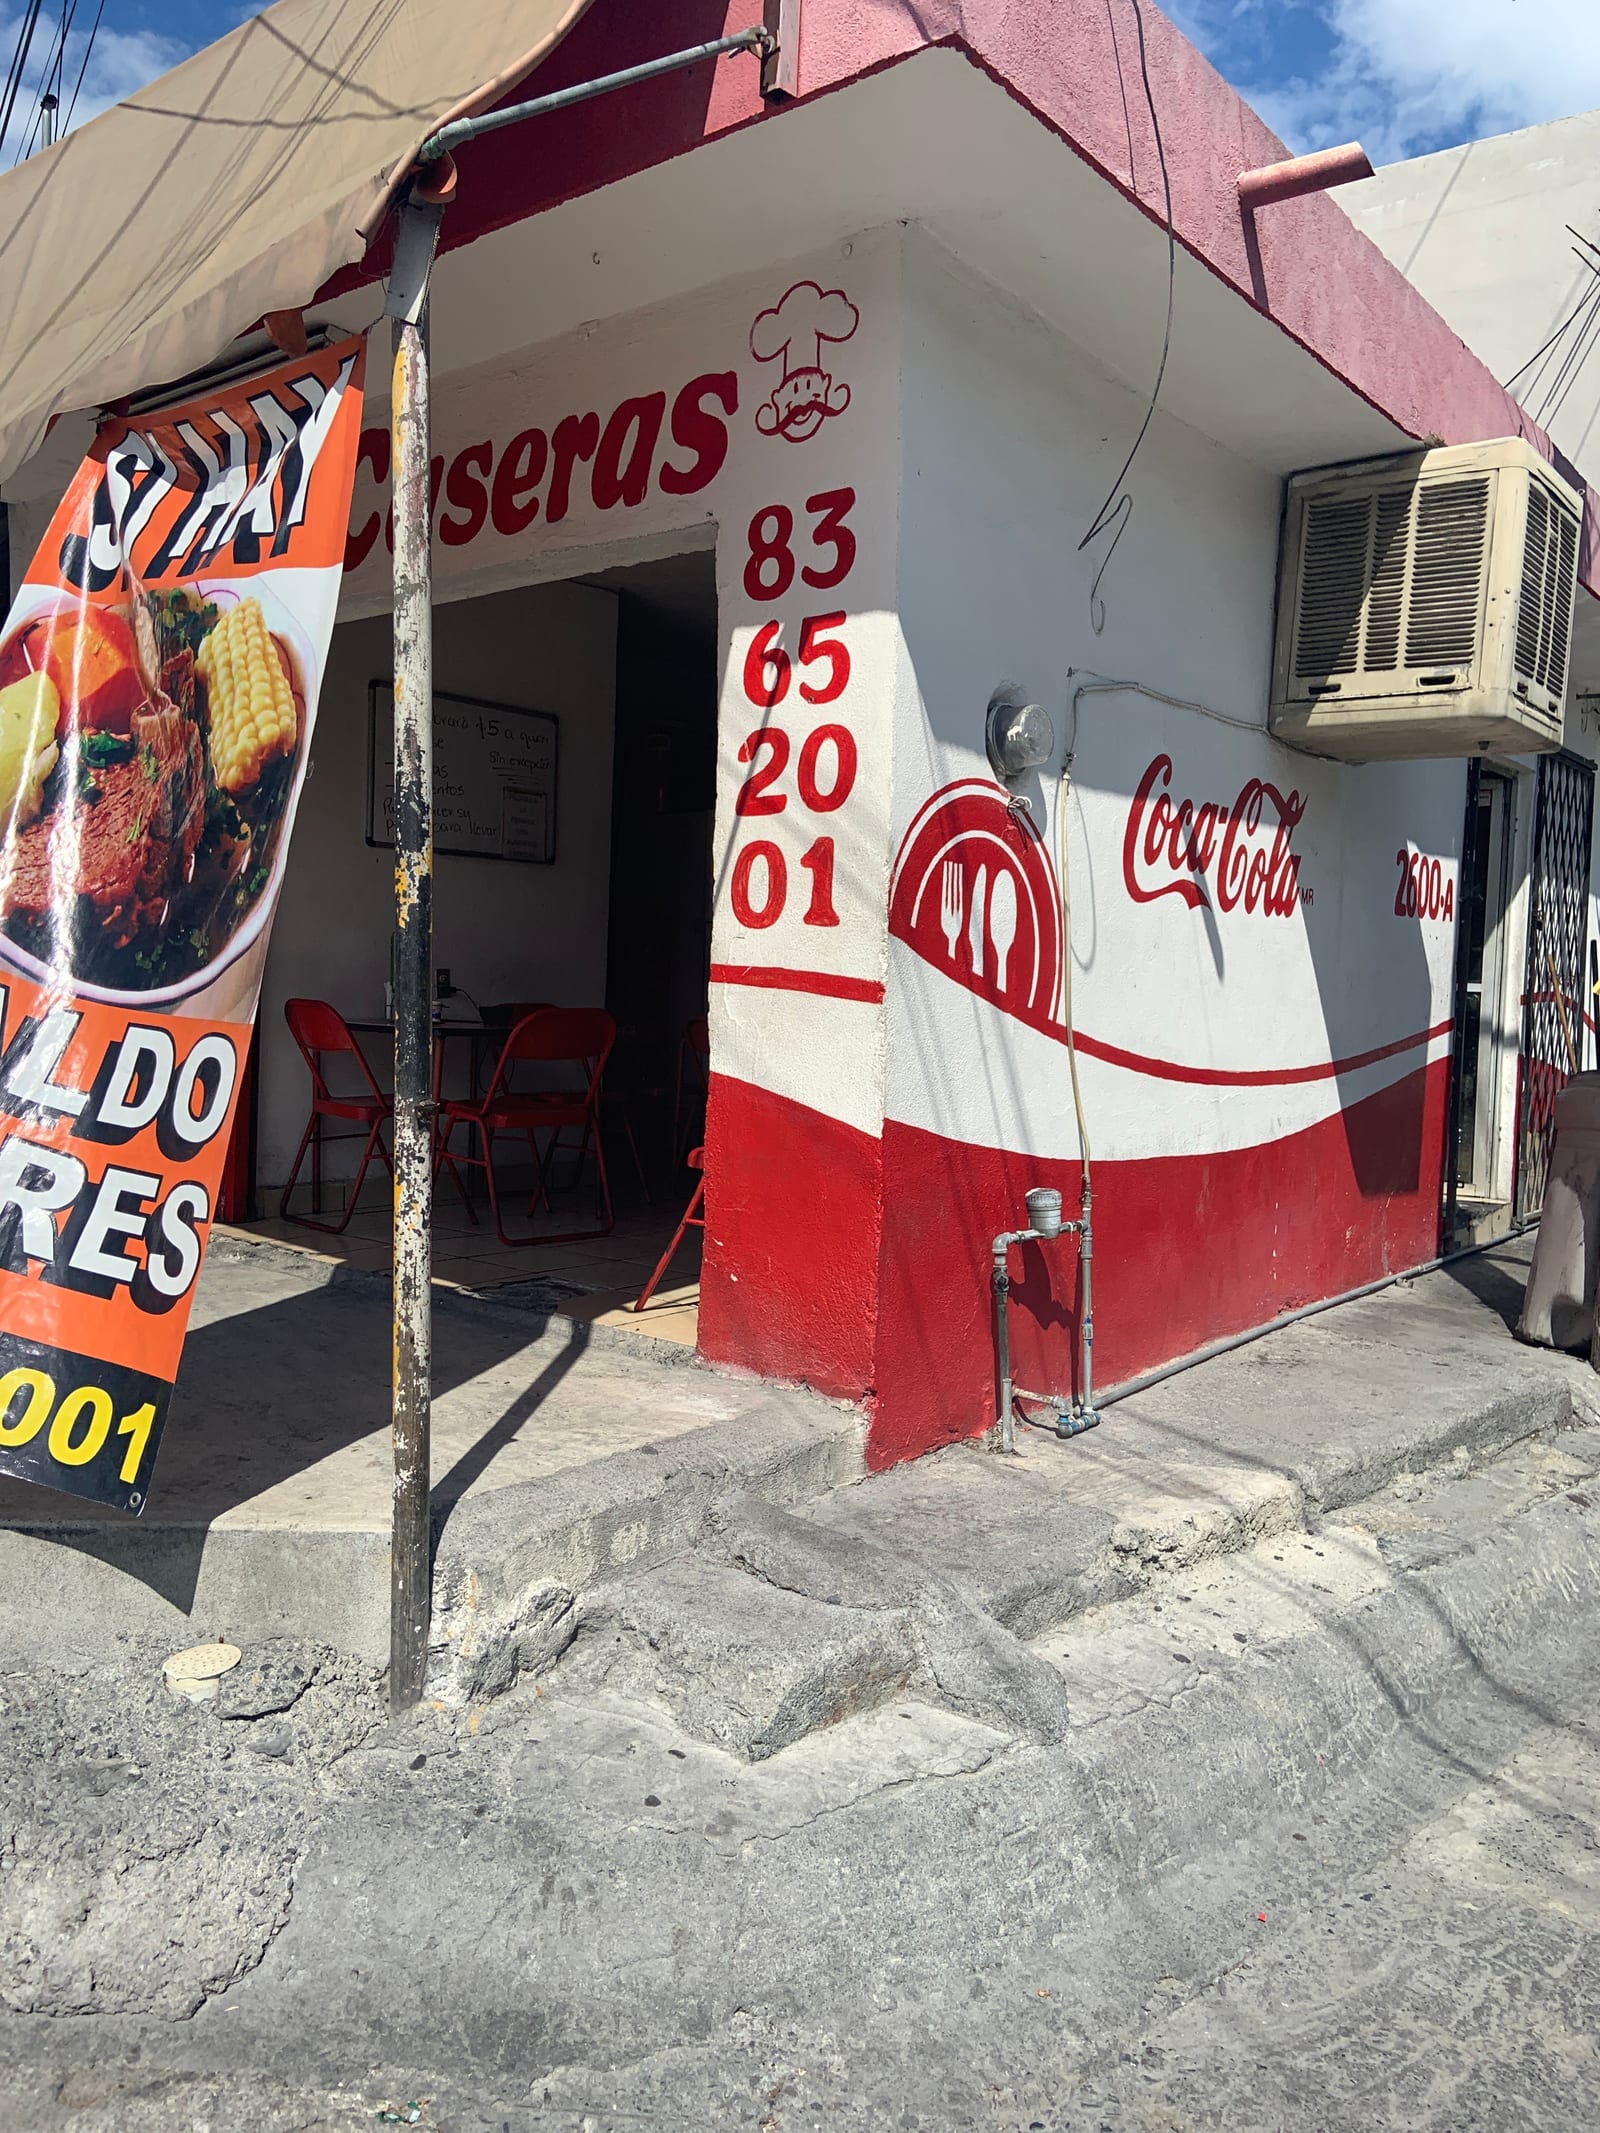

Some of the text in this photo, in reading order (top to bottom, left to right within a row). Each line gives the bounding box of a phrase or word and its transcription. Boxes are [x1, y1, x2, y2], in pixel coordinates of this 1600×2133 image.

[167, 351, 360, 559] HAY
[743, 487, 857, 601] 83
[743, 610, 851, 707] 65
[735, 723, 857, 817] 20
[731, 836, 840, 929] 01
[1122, 753, 1309, 918] Coca-Cola
[0, 985, 238, 1144] LDO
[0, 1133, 210, 1297] RES
[0, 1367, 157, 1484] 001
